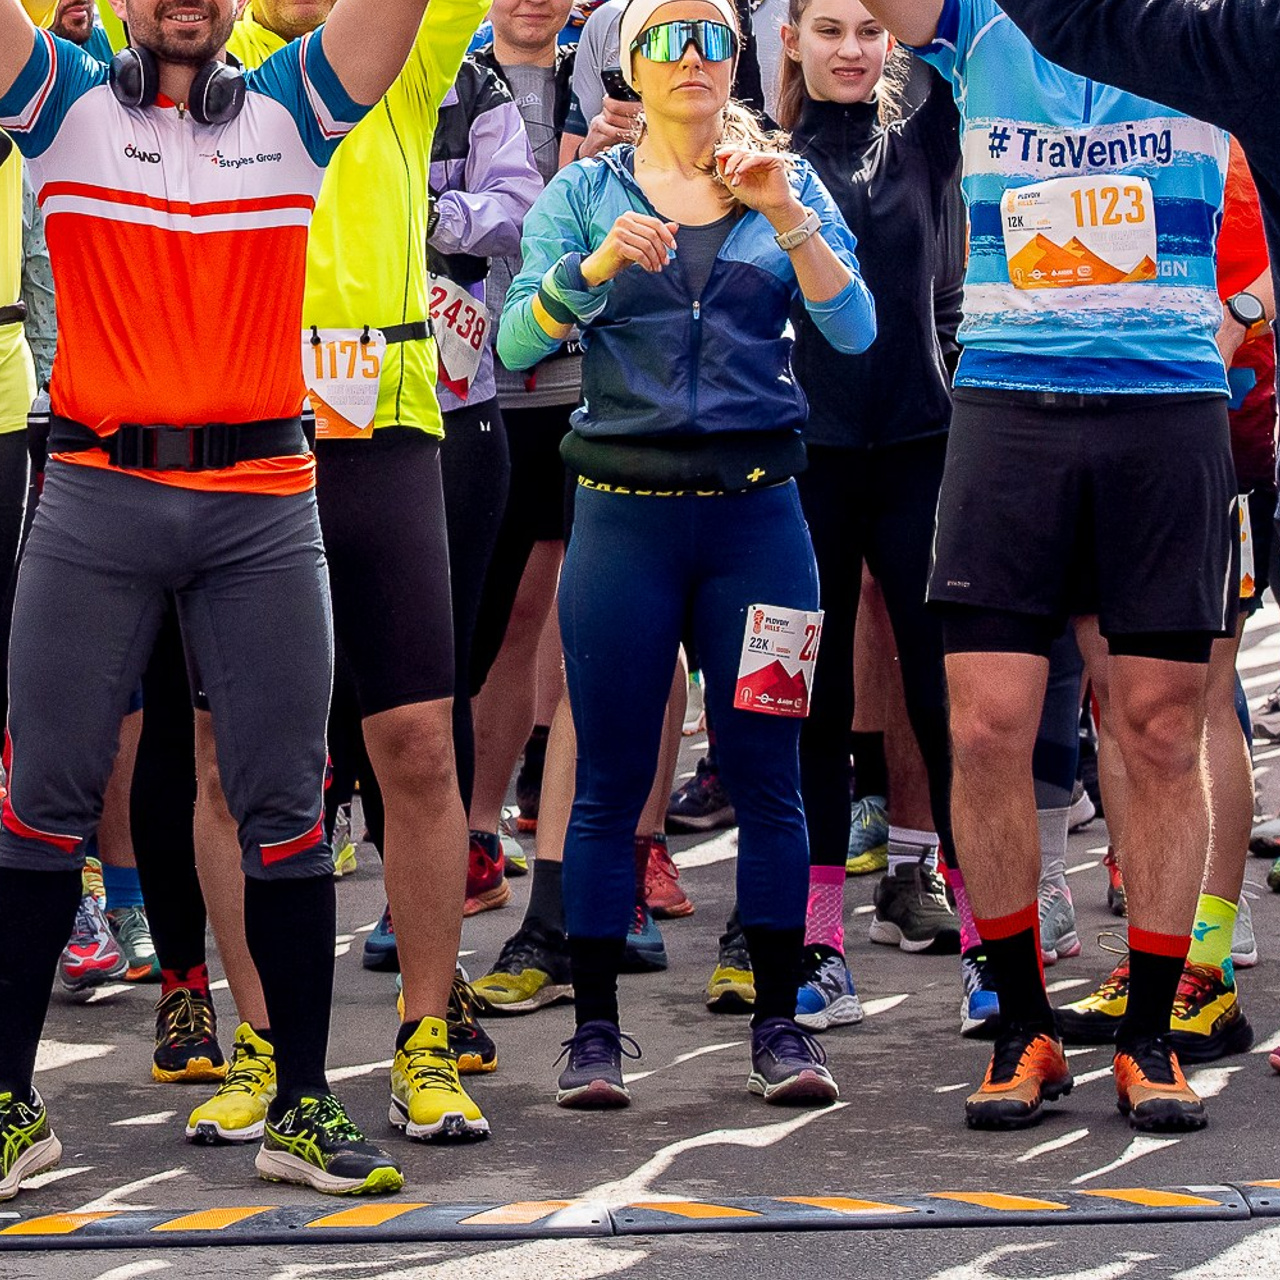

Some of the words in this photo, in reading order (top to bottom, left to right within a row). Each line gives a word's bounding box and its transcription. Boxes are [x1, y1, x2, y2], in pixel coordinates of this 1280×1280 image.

[219, 158, 254, 168] Strypes
[256, 152, 282, 163] Group
[1071, 185, 1145, 227] 1123
[1007, 216, 1024, 228] 12K
[429, 286, 486, 351] 2438
[312, 339, 379, 380] 1175
[749, 637, 769, 651] 22K
